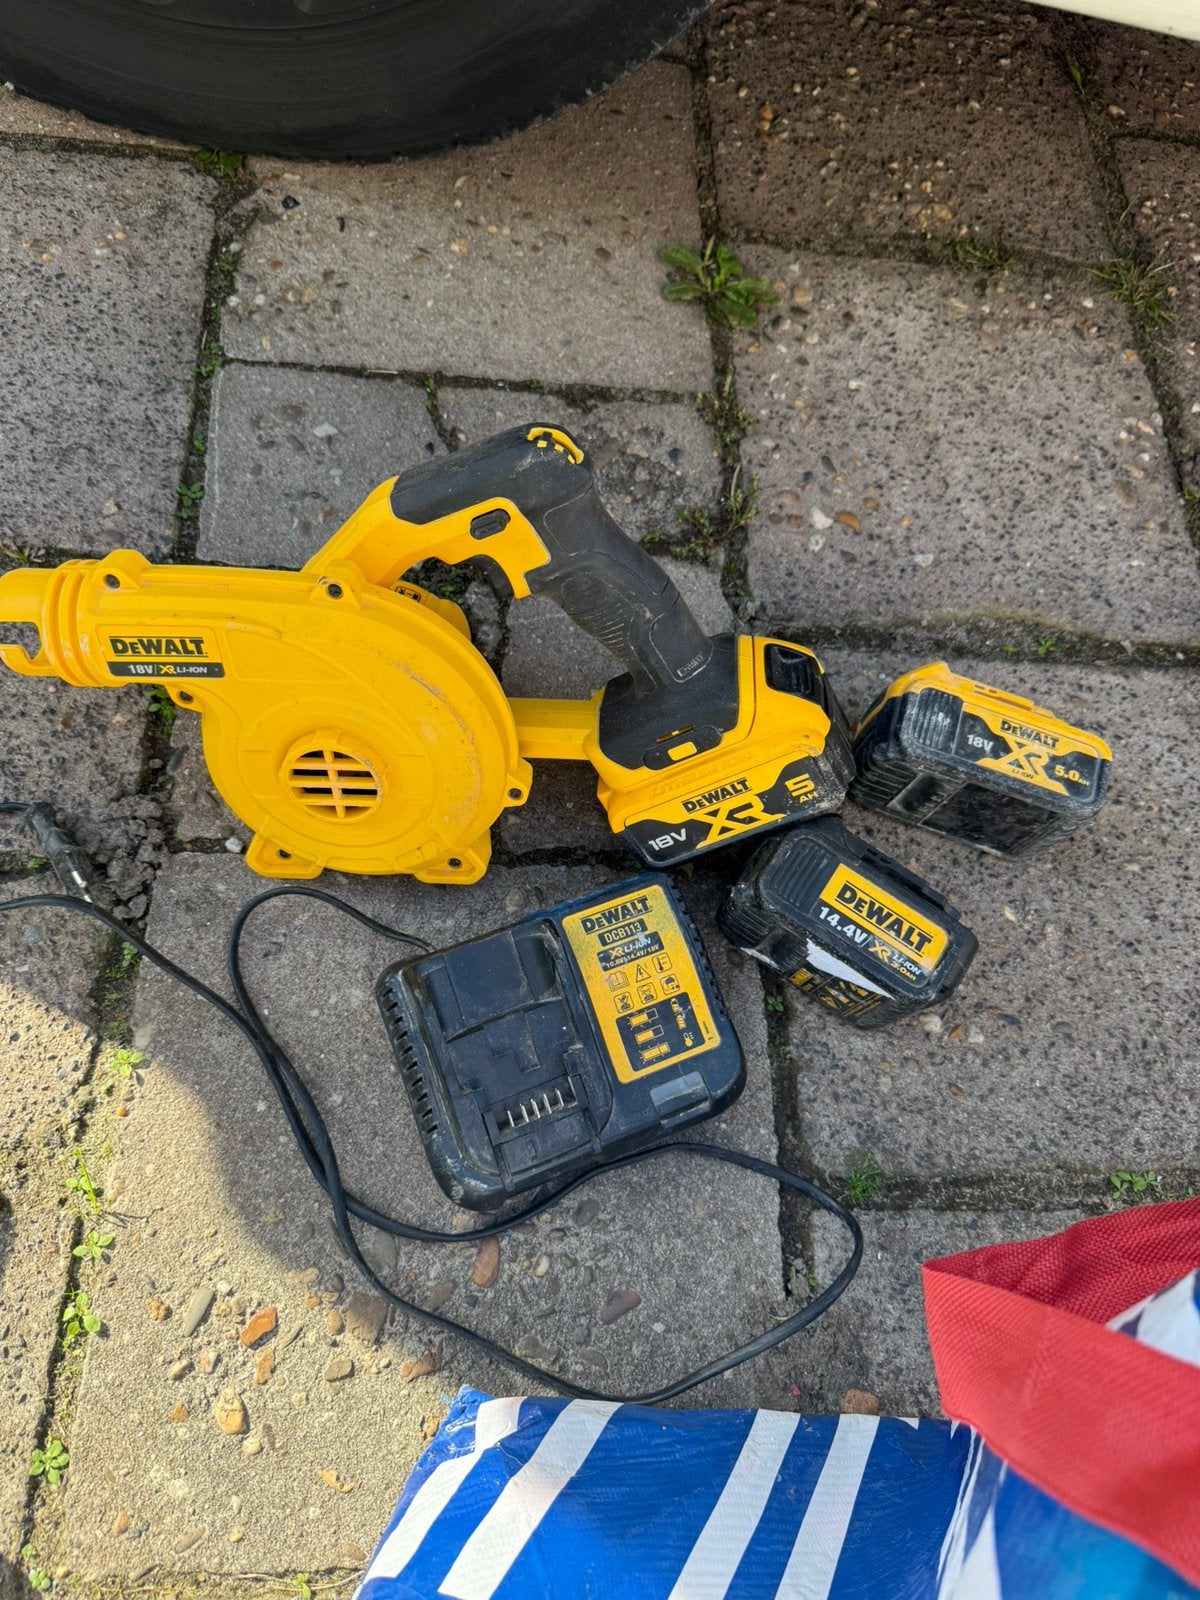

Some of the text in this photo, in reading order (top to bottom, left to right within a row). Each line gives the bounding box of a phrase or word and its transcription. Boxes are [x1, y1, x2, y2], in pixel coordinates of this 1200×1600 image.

[128, 664, 207, 675] 18V XR LI-ION
[966, 734, 995, 752] 18V
[648, 827, 688, 851] 18V
[784, 773, 816, 797] 5
[603, 922, 642, 944] DCB113
[818, 906, 868, 944] 14.4V
